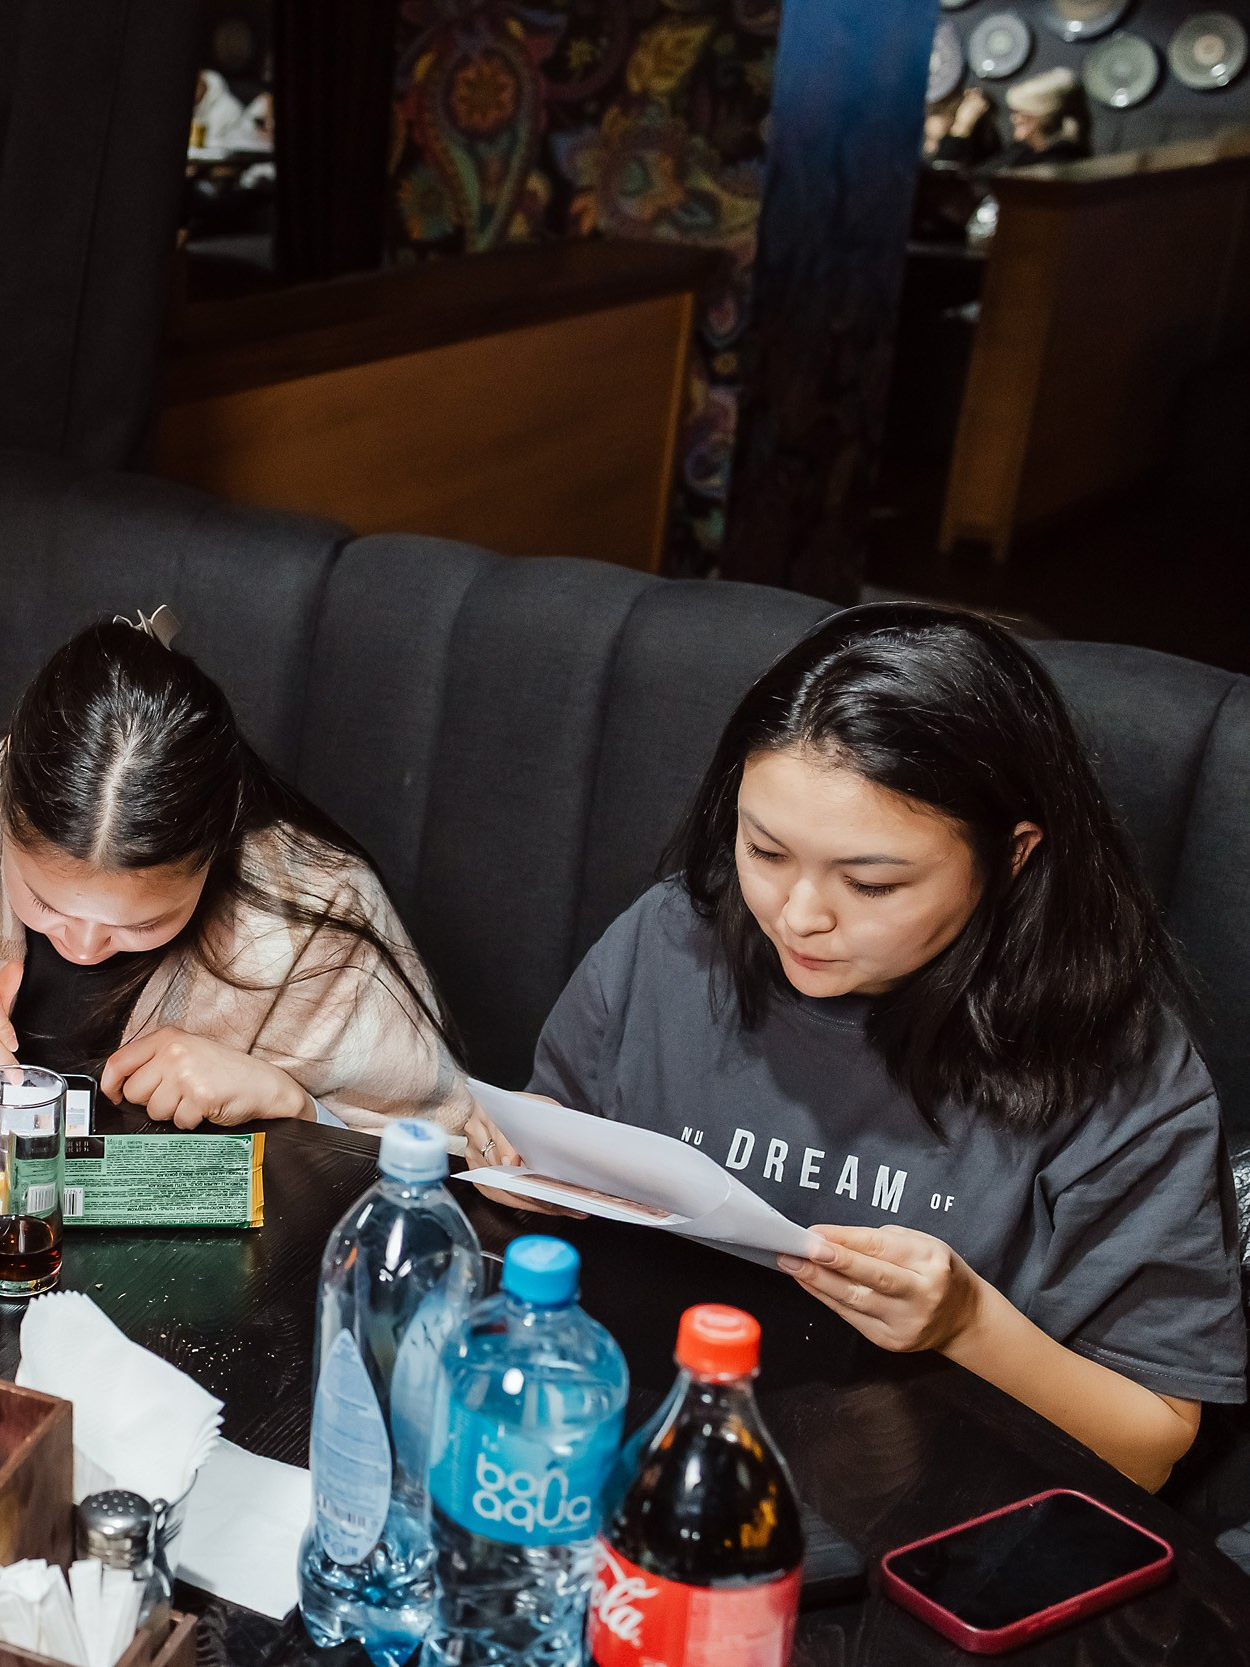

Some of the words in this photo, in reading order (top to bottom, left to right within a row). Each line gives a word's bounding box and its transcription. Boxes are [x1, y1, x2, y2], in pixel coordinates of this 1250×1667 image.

[681, 1126, 704, 1145] NU
[725, 1128, 908, 1213] DREAM
[931, 1193, 955, 1212] OF
